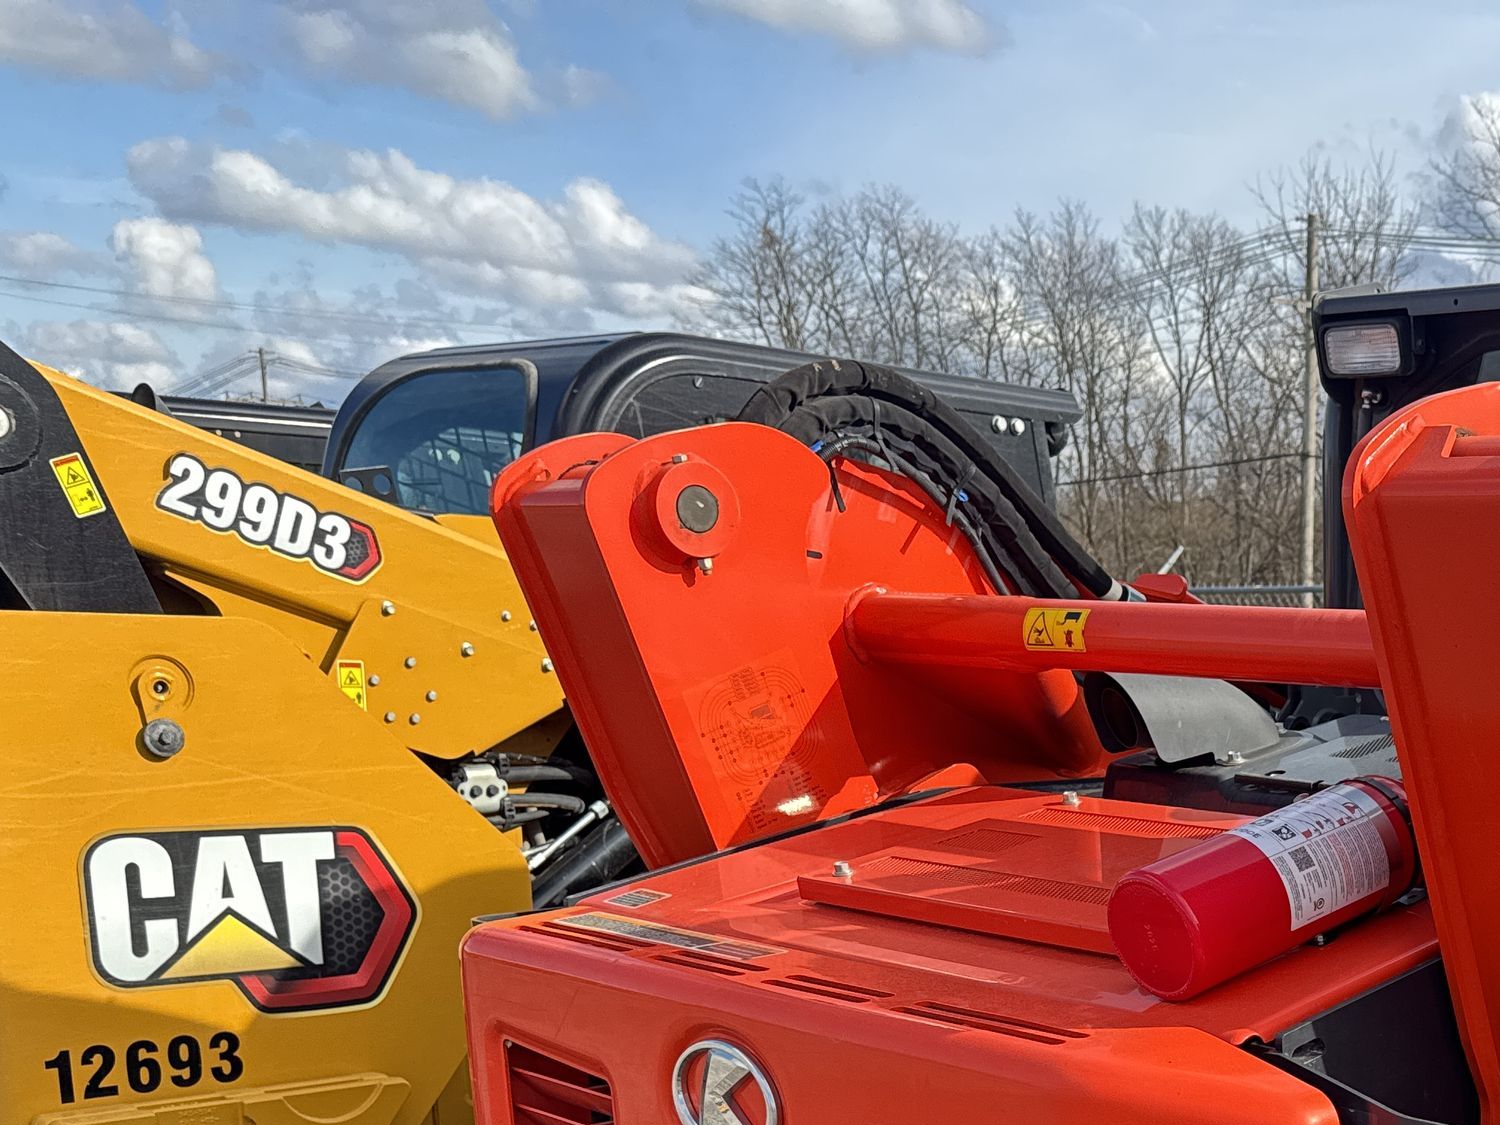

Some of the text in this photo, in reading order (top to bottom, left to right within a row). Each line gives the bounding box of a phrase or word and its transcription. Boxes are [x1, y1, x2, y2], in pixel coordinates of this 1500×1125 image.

[159, 456, 351, 570] 299D3
[90, 831, 336, 981] CAT
[44, 1031, 244, 1104] 12693
